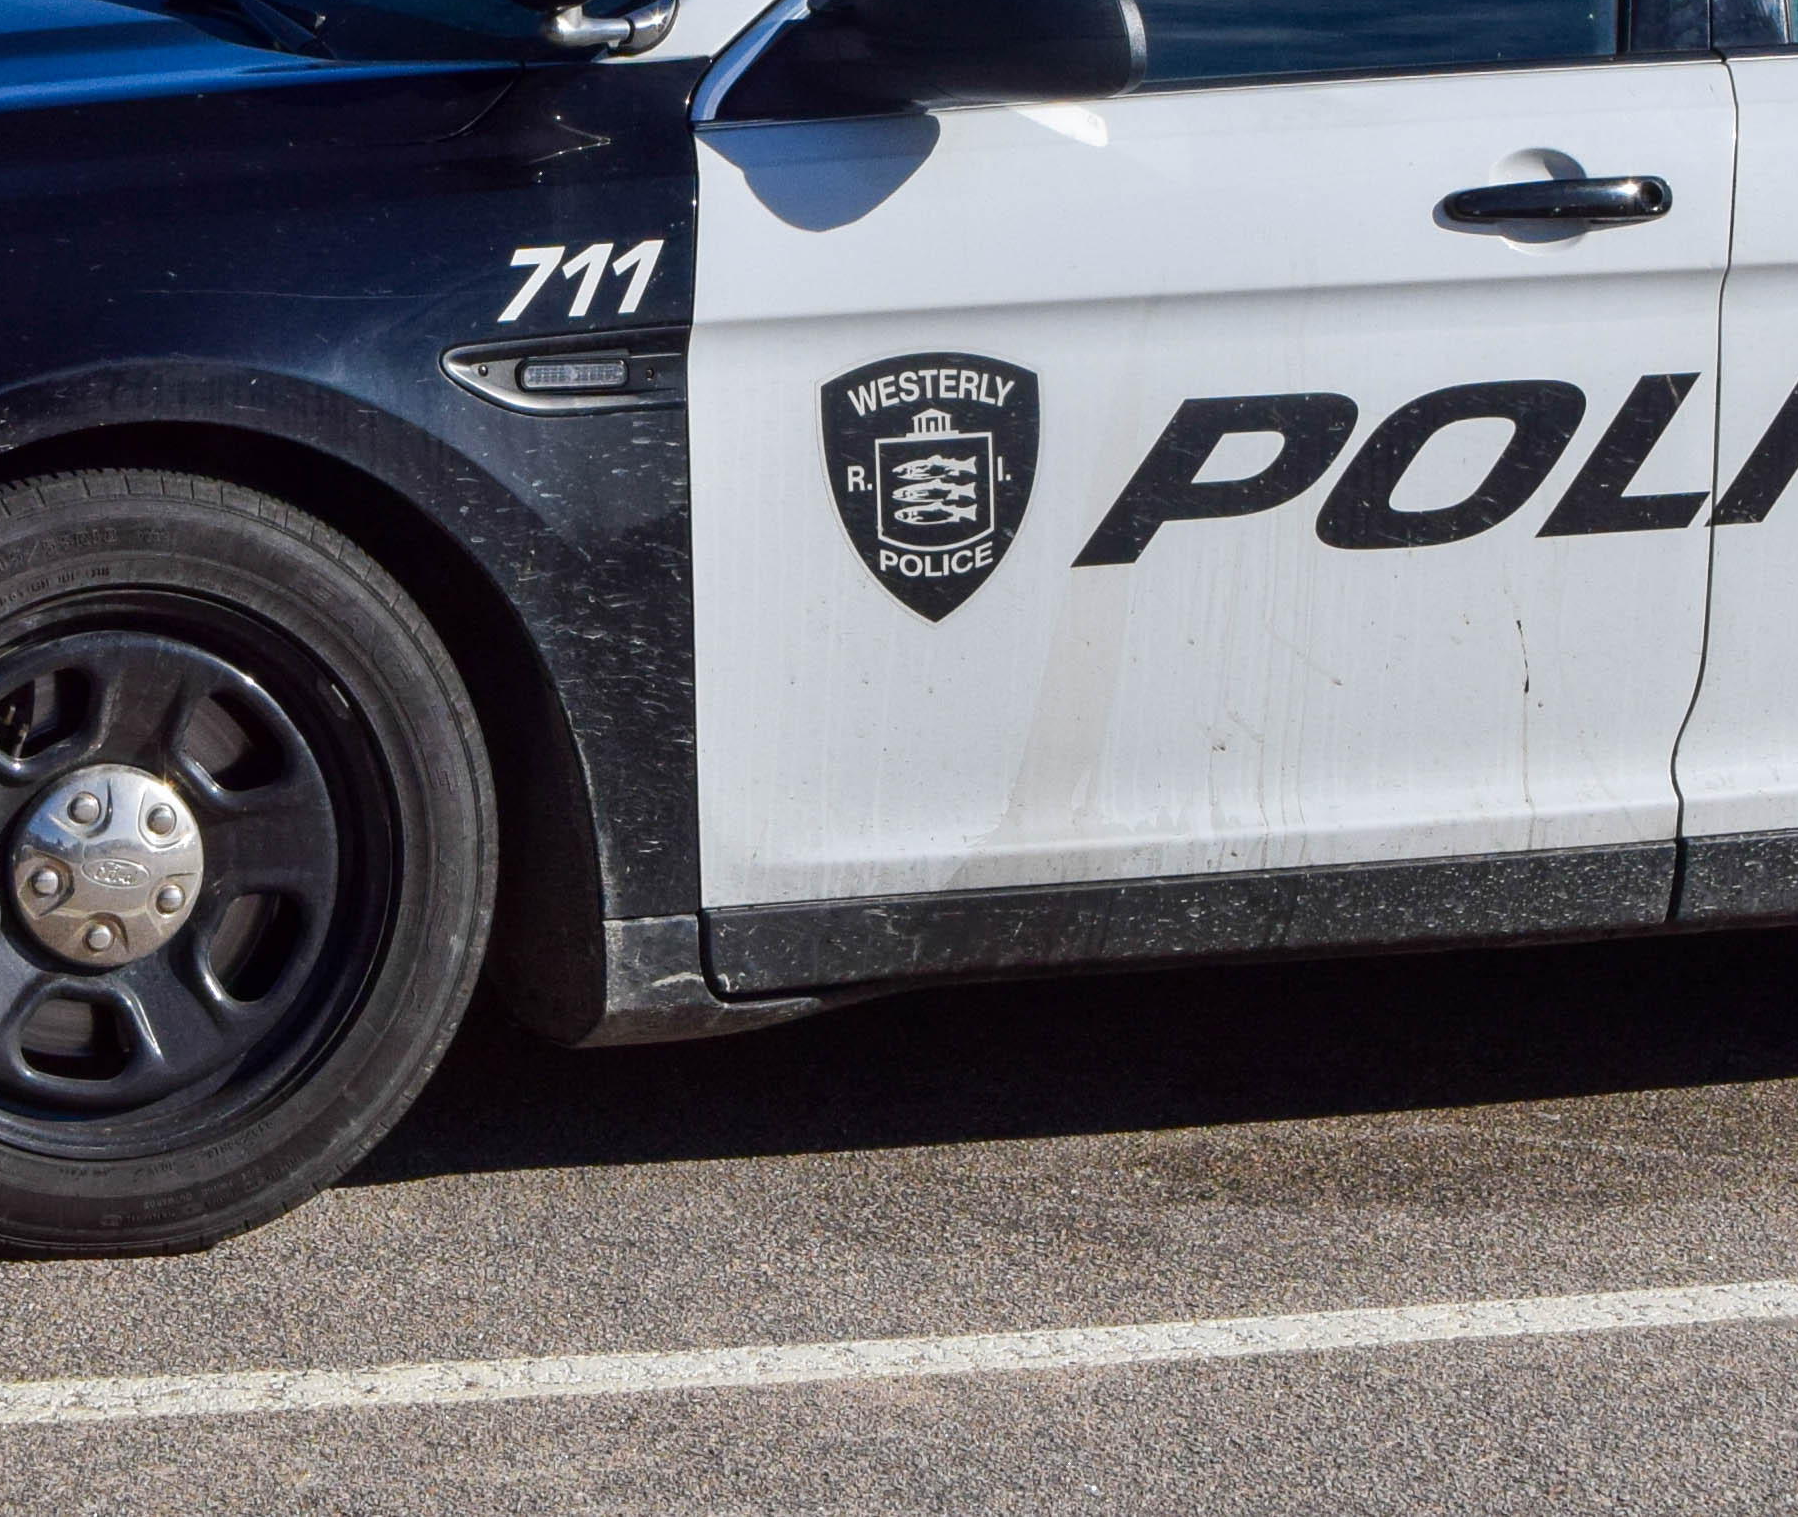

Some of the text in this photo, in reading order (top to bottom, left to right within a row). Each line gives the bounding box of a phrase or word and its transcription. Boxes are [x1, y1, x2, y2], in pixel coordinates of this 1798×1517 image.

[497, 239, 665, 323] 711
[847, 369, 1015, 417] WESTERLY
[847, 465, 873, 492] R.
[879, 541, 994, 577] POLICE
